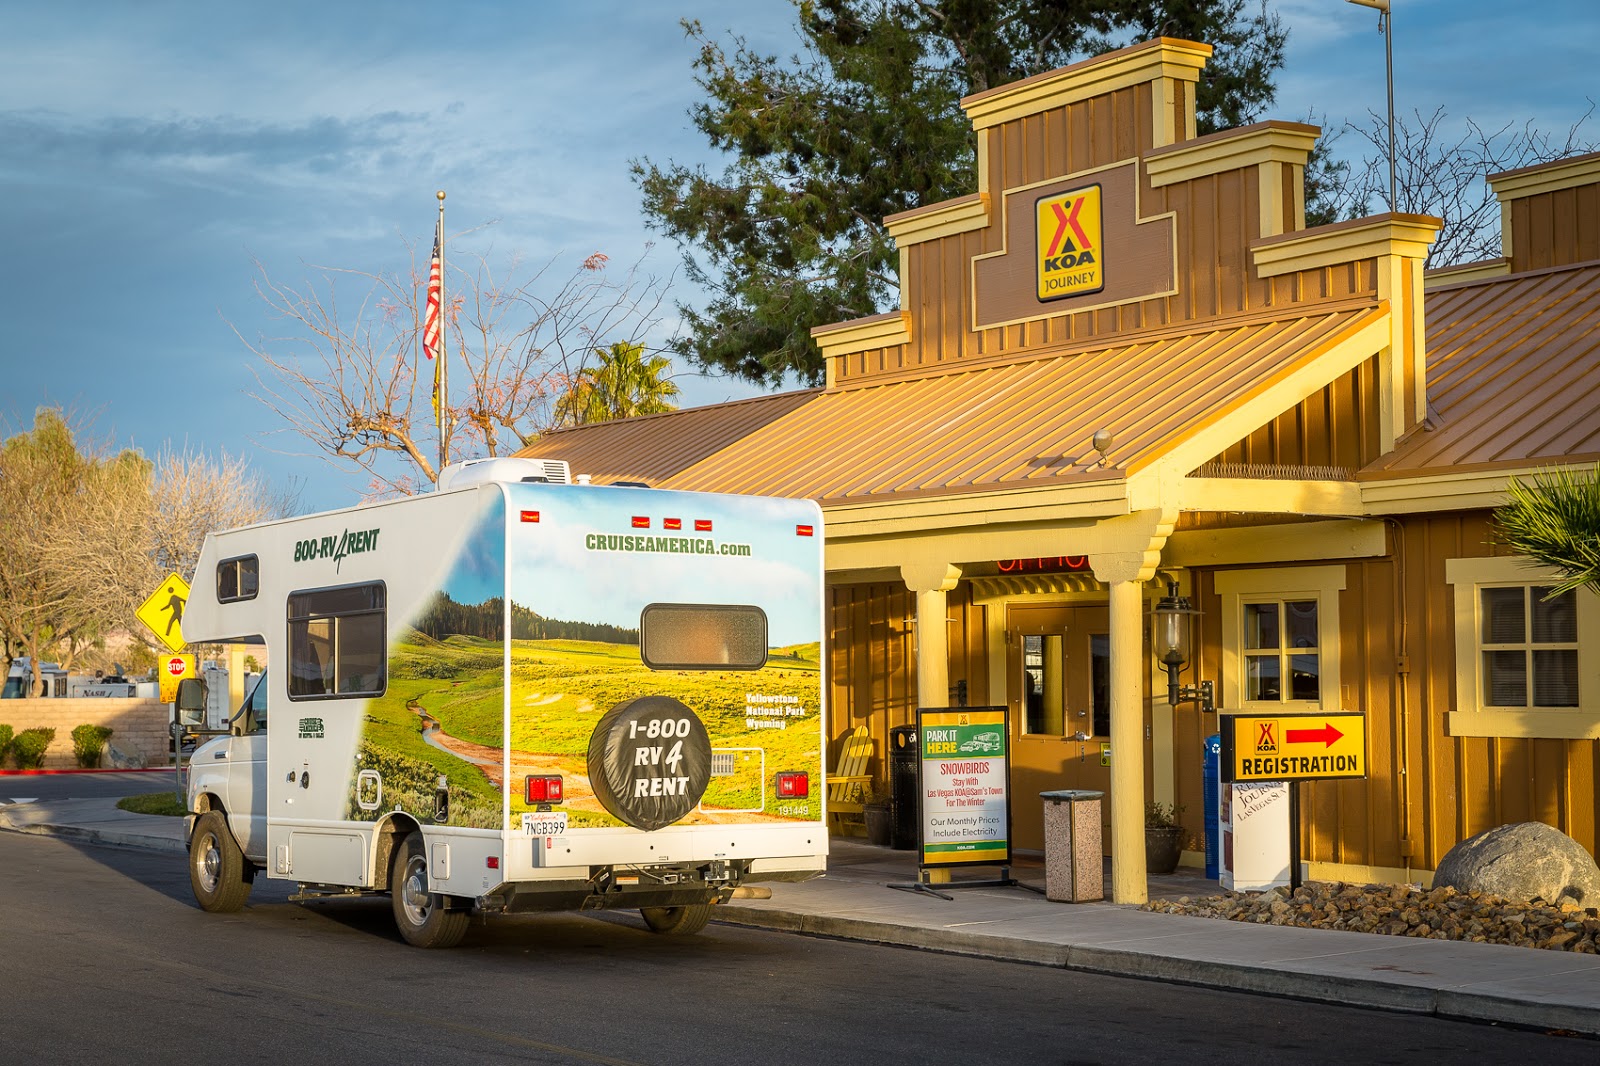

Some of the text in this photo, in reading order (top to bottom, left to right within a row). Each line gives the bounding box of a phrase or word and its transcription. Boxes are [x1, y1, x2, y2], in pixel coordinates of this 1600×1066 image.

[1044, 250, 1095, 273] KOA
[1045, 271, 1095, 292] JOURNEY
[585, 533, 751, 556] CRUISEAMERICA.com
[168, 663, 185, 671] STOP
[82, 689, 106, 697] NASH
[746, 693, 798, 703] Yellowstone
[746, 705, 805, 716] National Park
[629, 718, 691, 739] 1-800
[746, 718, 786, 730] Wyoming
[926, 729, 957, 742] PARK IT
[926, 741, 958, 754] HERE
[940, 761, 990, 775] SNOWBIRDS
[1242, 755, 1357, 775] REGISTRATION
[634, 776, 690, 798] RENT
[952, 777, 978, 787] Stay With
[927, 786, 1003, 798] Las Vegas KOA@Sam's Town
[1239, 782, 1281, 809] JOURN
[946, 797, 985, 807] For The Winter
[778, 805, 809, 816] 191449
[930, 816, 1000, 826] Our Monthly Prices
[525, 821, 565, 836] 7NGB399
[933, 827, 998, 837] Include Electricity
